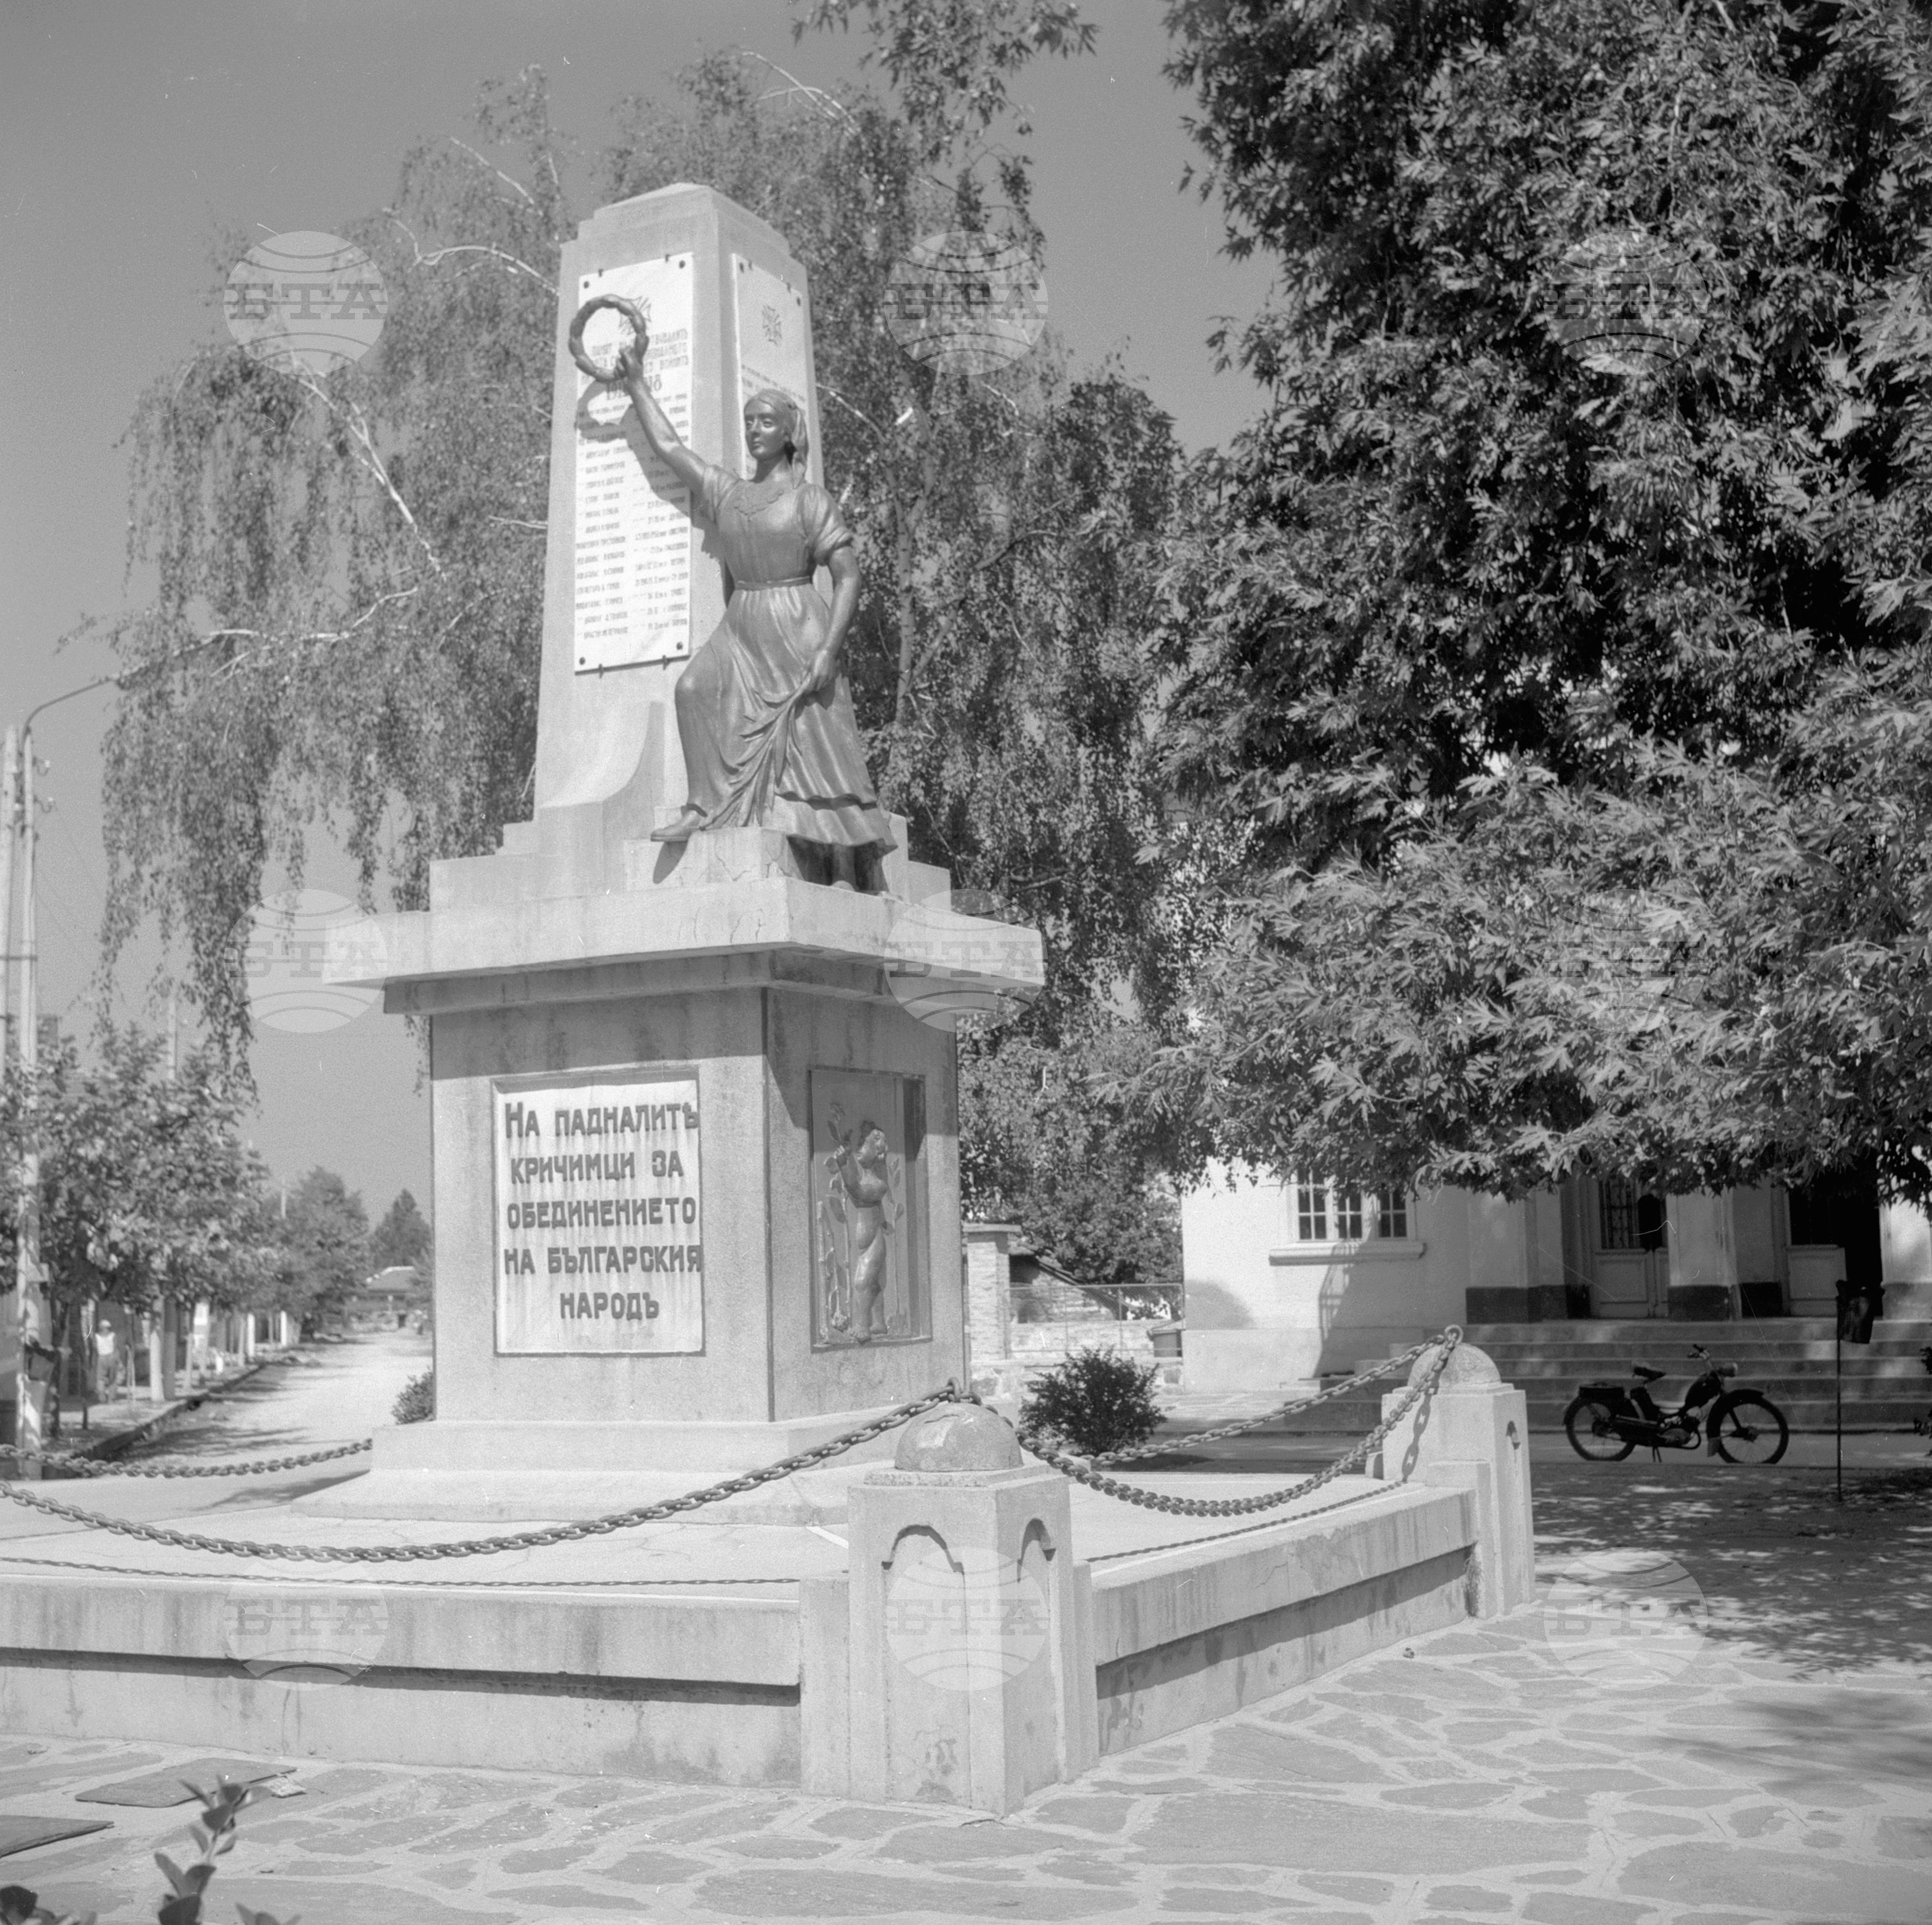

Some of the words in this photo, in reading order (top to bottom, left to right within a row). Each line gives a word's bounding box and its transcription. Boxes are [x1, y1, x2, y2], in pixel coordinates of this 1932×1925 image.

[505, 1102, 540, 1138] НА
[511, 1152, 635, 1184] КРИЧИМЦИ
[652, 1150, 684, 1178] ЗА
[507, 1197, 696, 1229] ОБЕДИНЕНИЕТО
[504, 1248, 535, 1274] НА
[547, 1244, 702, 1274] БЪЛГАРСКИЯ
[560, 1292, 660, 1321] НАРОДЪ
